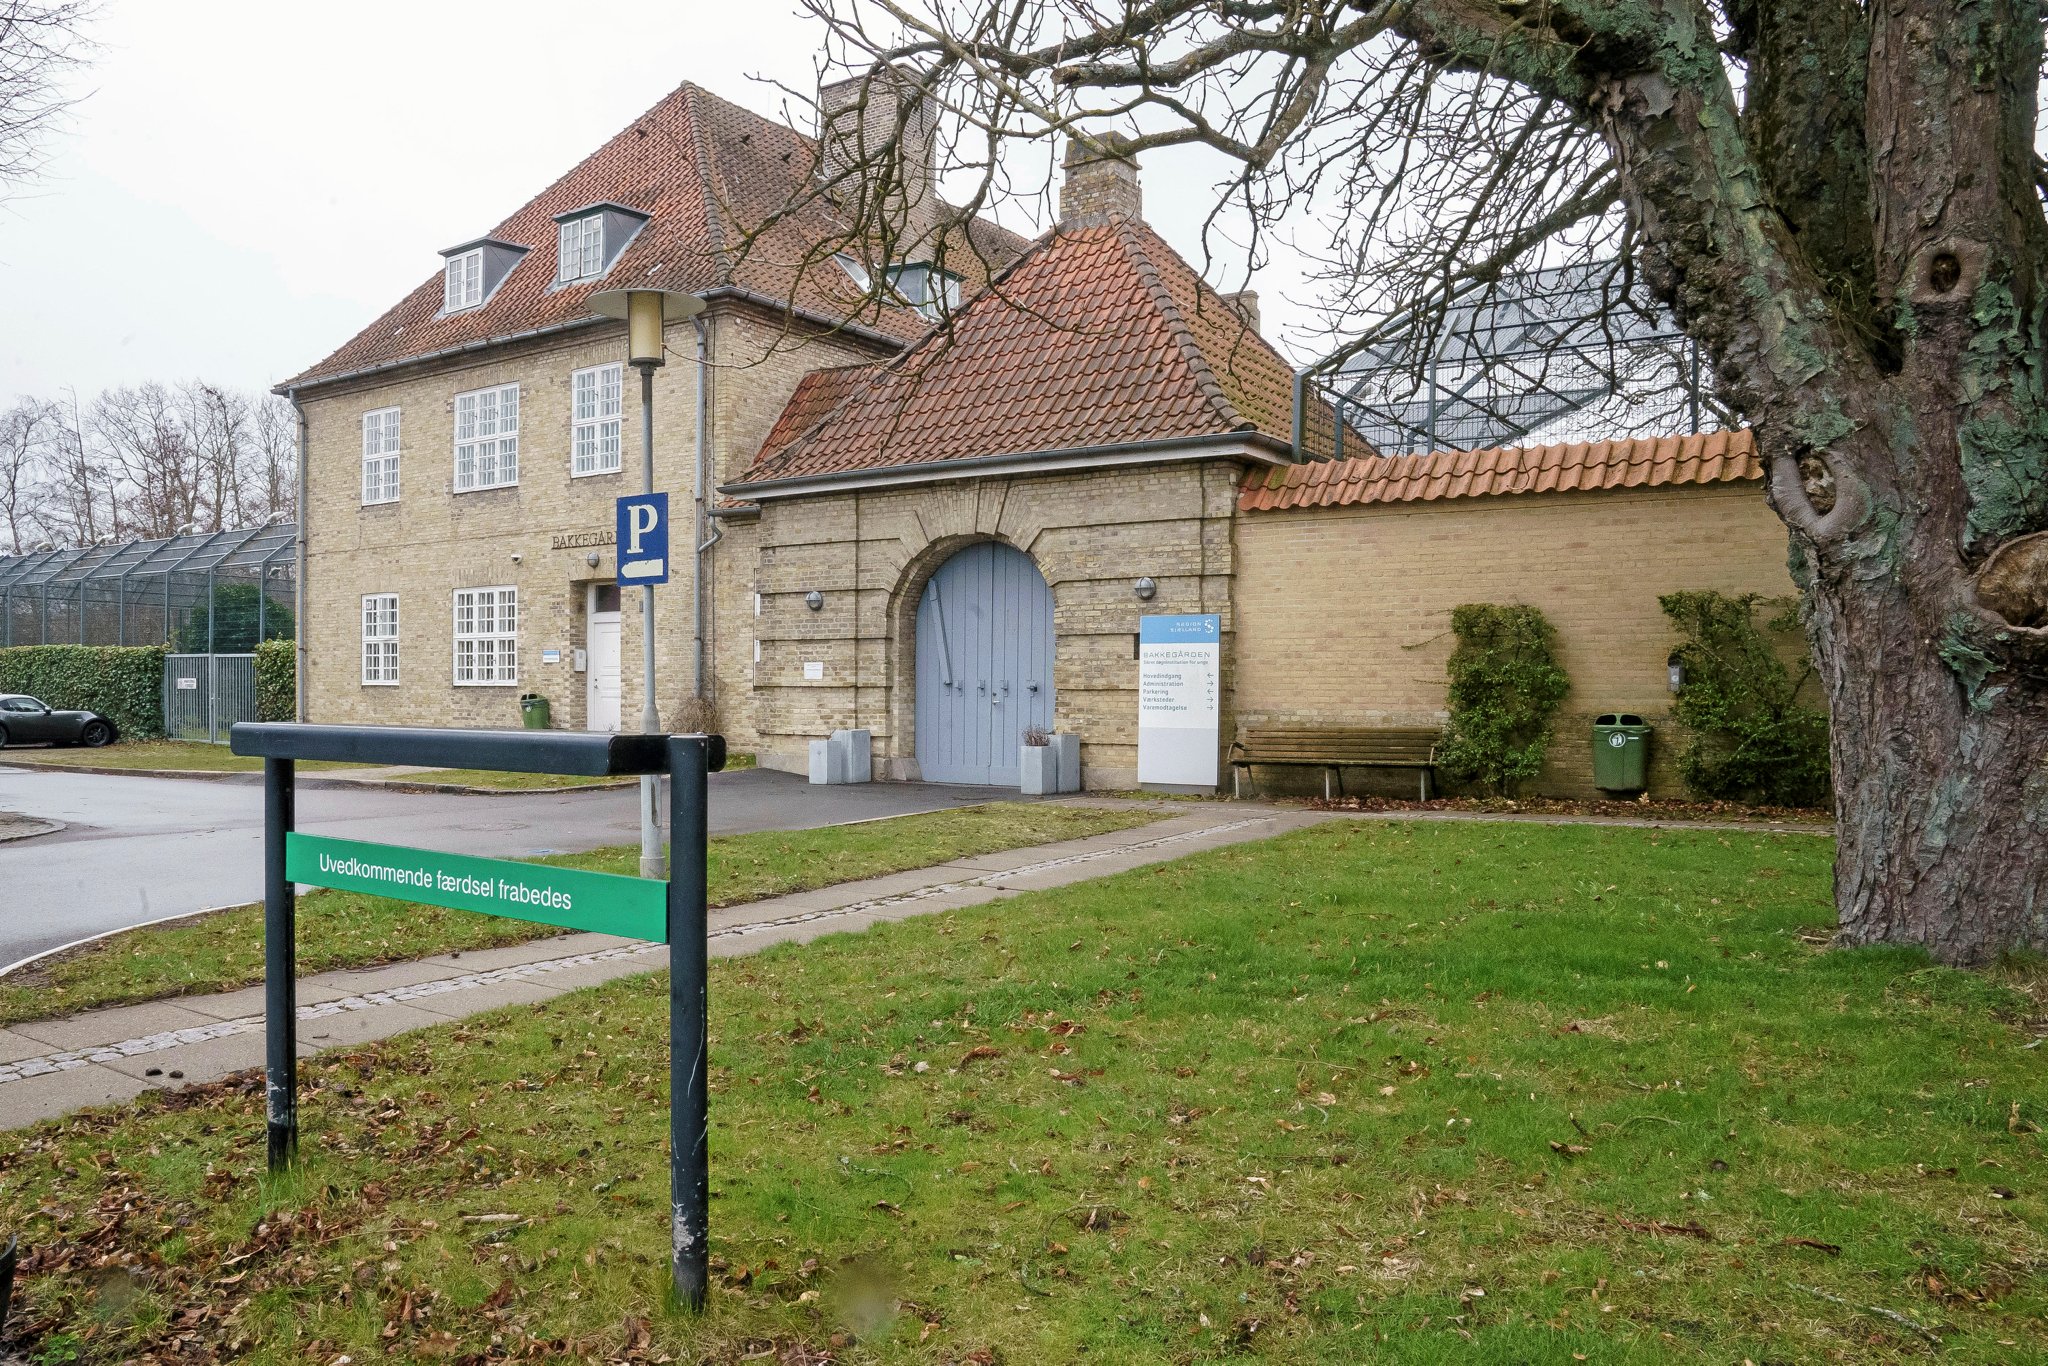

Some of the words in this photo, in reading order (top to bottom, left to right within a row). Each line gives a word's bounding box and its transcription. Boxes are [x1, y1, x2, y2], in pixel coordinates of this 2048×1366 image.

[626, 504, 659, 554] P
[551, 530, 617, 549] BAKKEGÅR
[1143, 650, 1211, 658] BAKKEGÅRDEN
[1143, 672, 1182, 680] Hovedindgang
[319, 852, 433, 888] Uvedkommende
[436, 870, 494, 898] færdsel
[498, 879, 572, 910] frabedes
